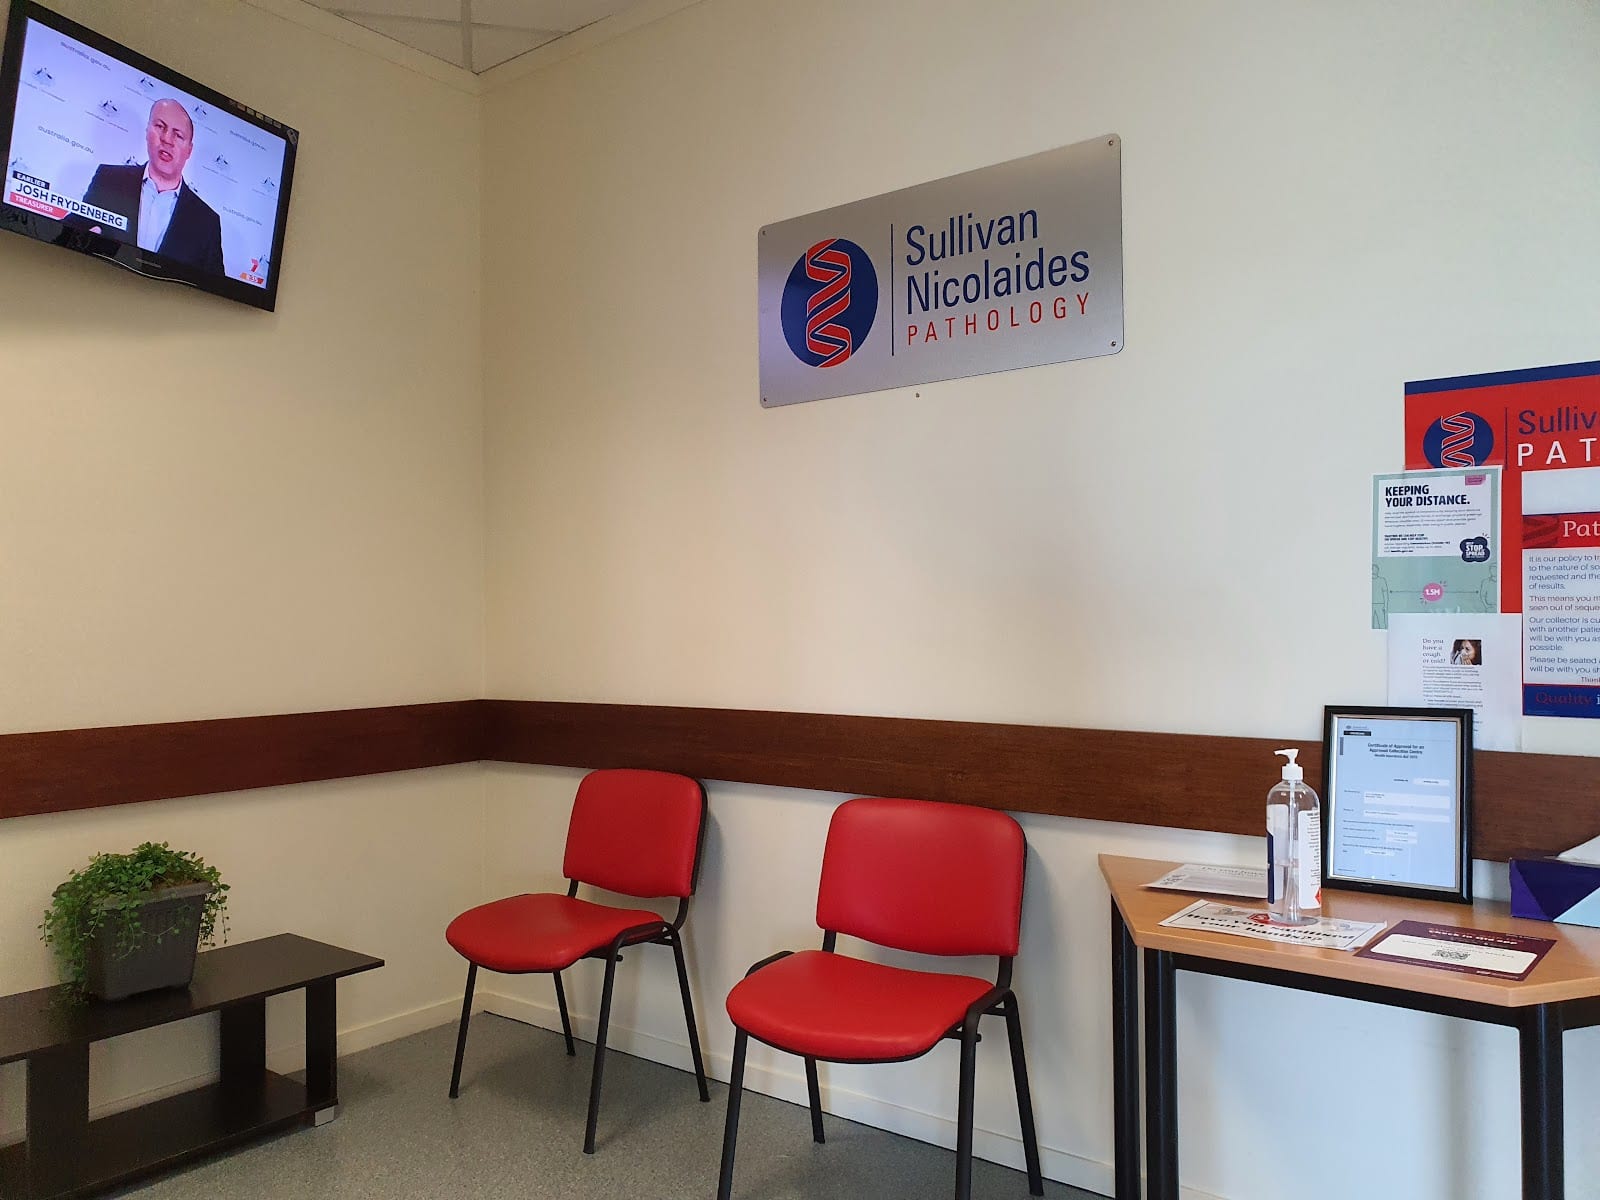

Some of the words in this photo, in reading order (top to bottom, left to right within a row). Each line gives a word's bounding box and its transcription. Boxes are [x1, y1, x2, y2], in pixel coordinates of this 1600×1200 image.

[17, 173, 46, 188] EARLIER
[15, 195, 54, 213] TREASURER
[16, 183, 49, 201] JOSH
[50, 194, 123, 227] FRYDENBERG
[905, 208, 1038, 266] Sullivan
[907, 247, 1089, 314] Nicolaides
[908, 292, 1089, 345] PATHOLOGY
[1518, 406, 1598, 435] Sulliv
[1517, 437, 1598, 467] PAT
[1385, 485, 1430, 497] KEEPING
[1385, 497, 1413, 508] YOUR
[1416, 494, 1471, 507] DISTANCE.
[1558, 555, 1582, 563] policy
[1529, 574, 1569, 582] requested
